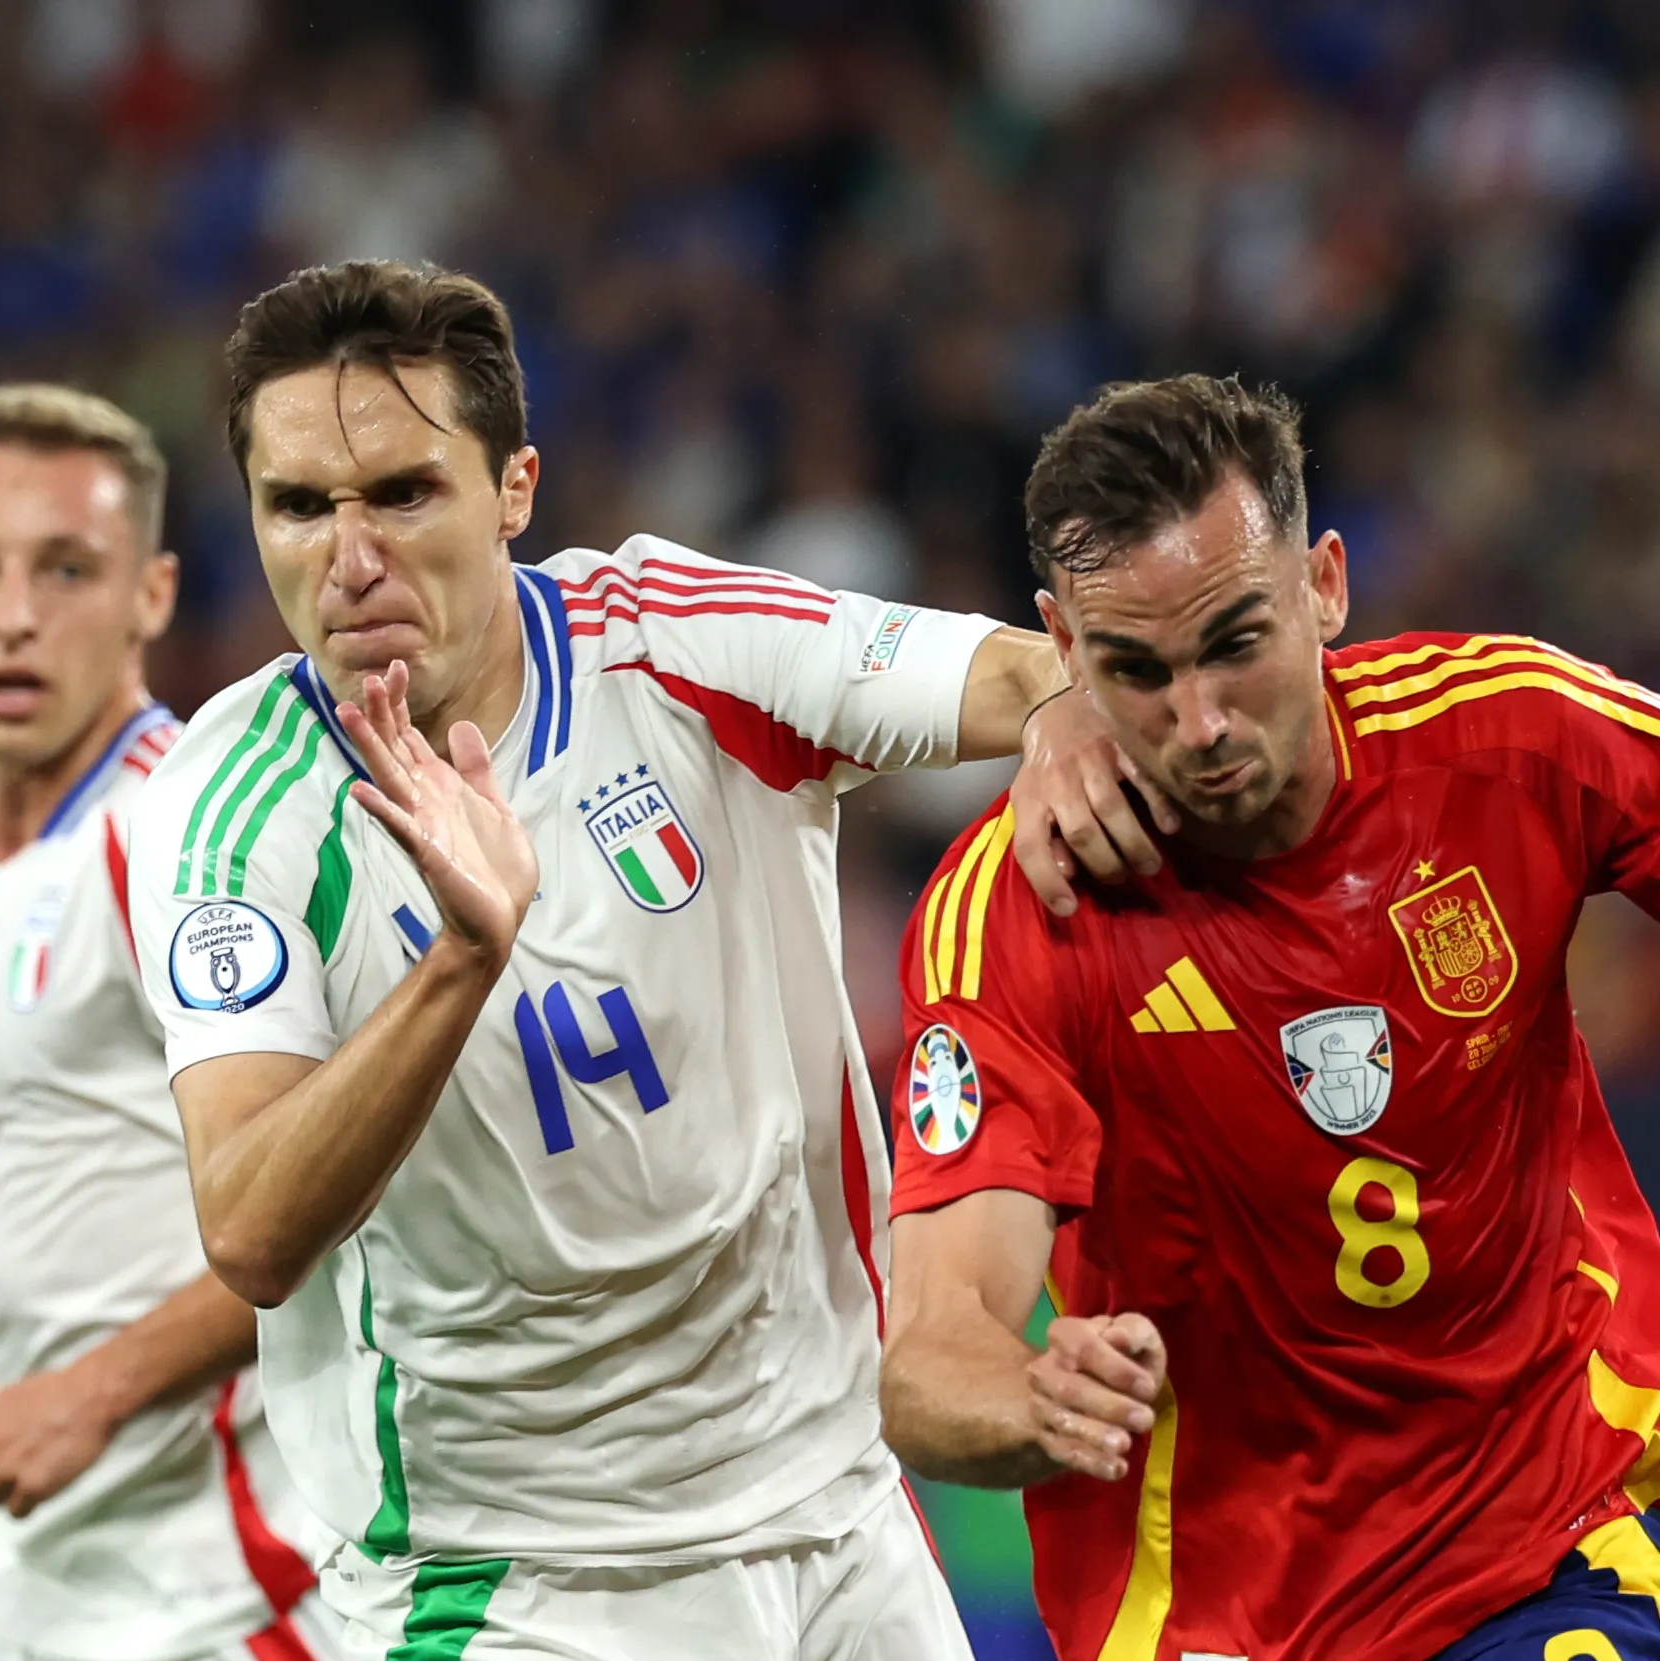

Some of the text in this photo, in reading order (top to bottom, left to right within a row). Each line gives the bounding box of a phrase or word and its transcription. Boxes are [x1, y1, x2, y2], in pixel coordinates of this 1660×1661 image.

[870, 604, 914, 671] FOUNDA
[859, 644, 875, 672] UEFA
[595, 793, 664, 844] ITALIA
[197, 908, 235, 925] UEFA
[187, 922, 253, 945] EUROPEAN
[189, 933, 255, 956] CHAMPIONS
[1306, 1010, 1343, 1026] NATIONS
[514, 979, 670, 1156] 14
[1326, 1120, 1360, 1131] WINNER
[1328, 1156, 1431, 1309] 8
